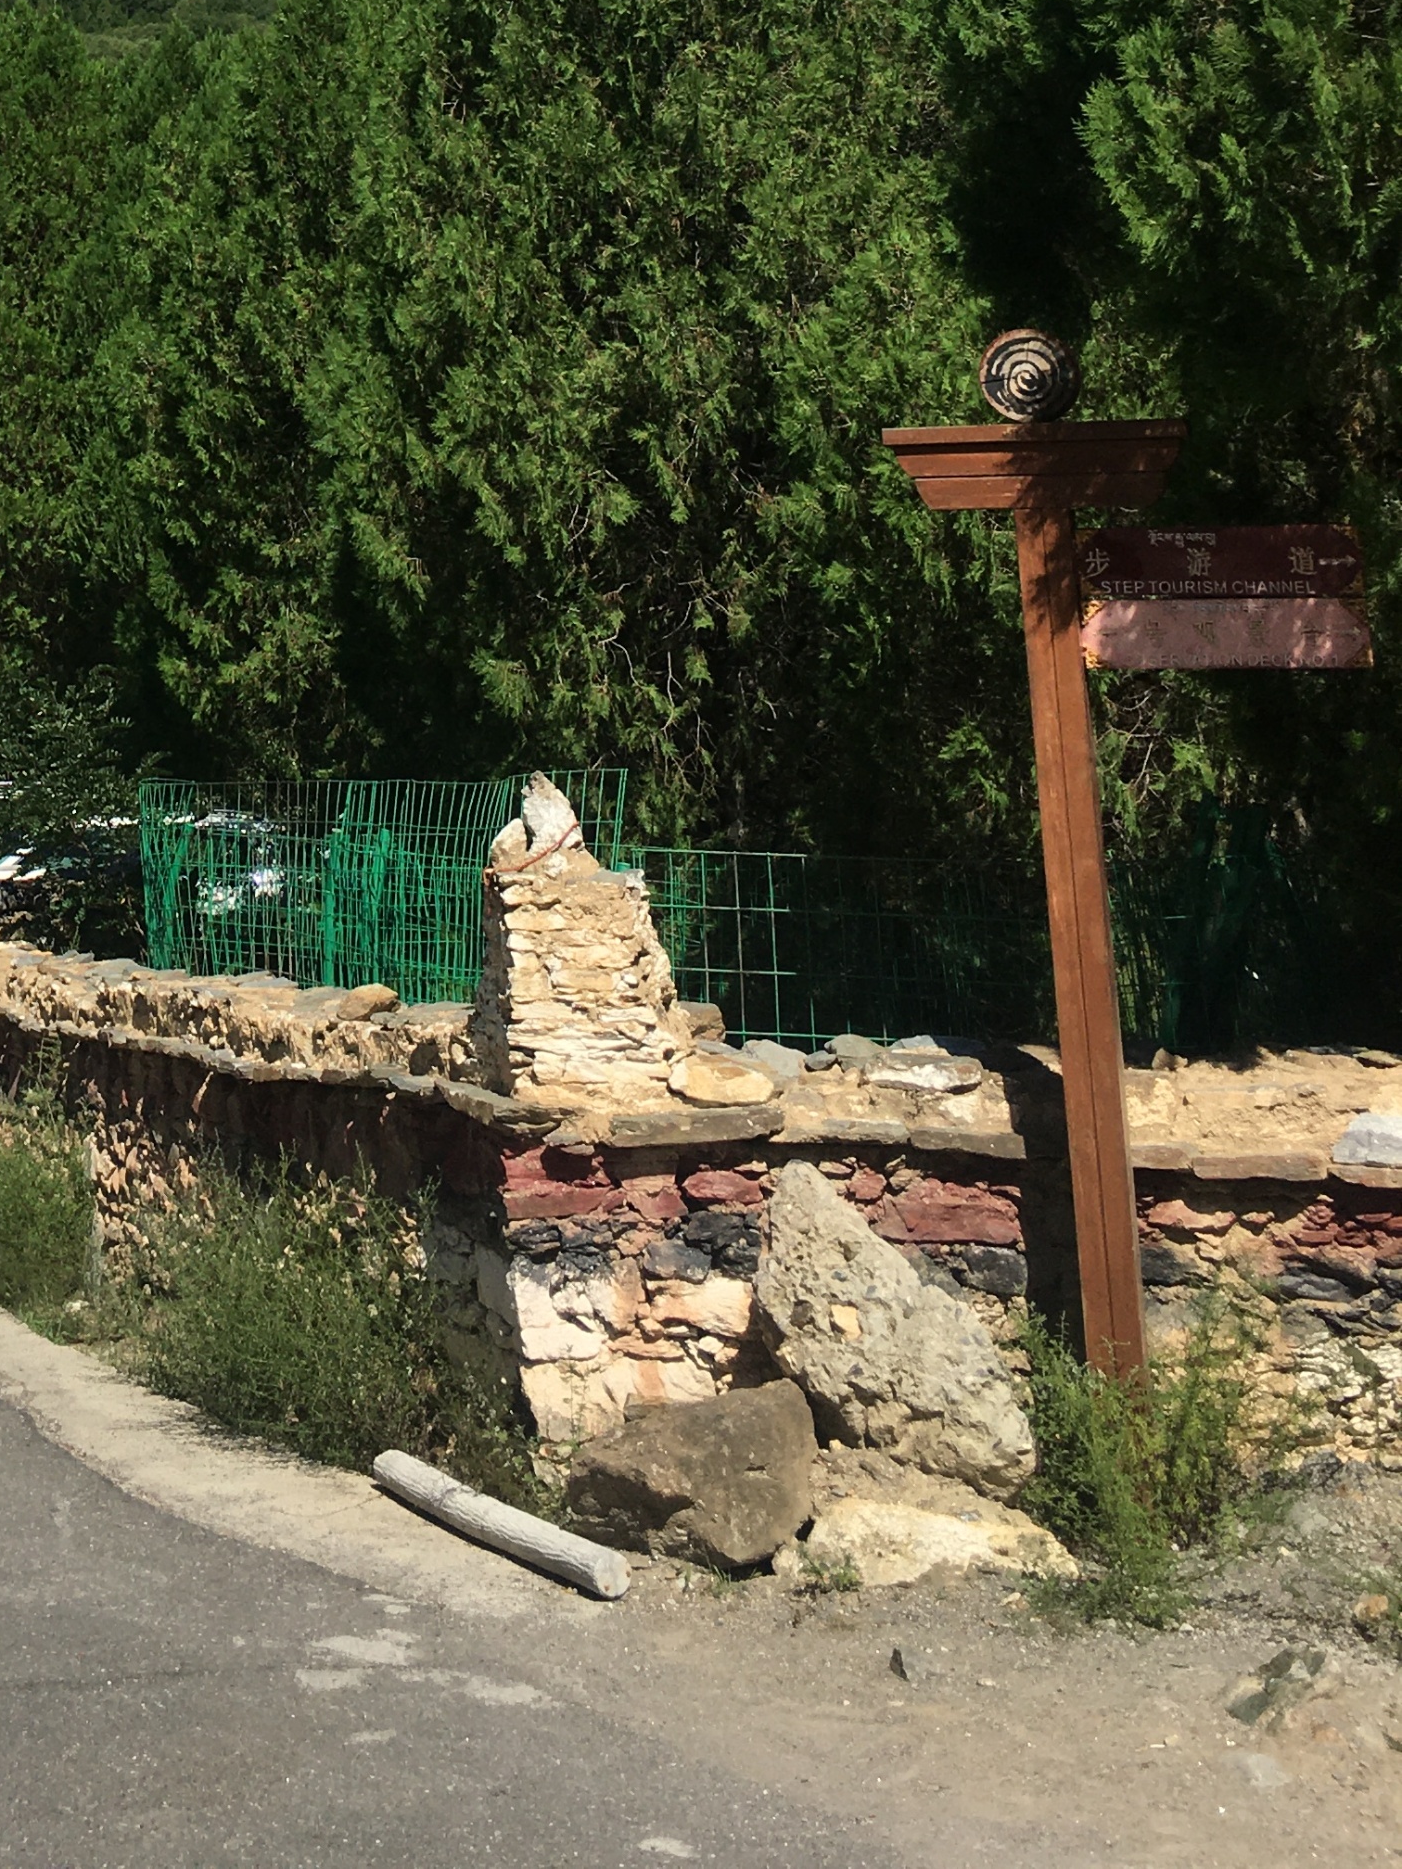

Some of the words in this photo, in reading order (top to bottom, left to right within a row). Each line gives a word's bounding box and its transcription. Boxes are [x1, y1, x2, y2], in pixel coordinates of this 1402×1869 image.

[1100, 580, 1145, 594] STEP
[1150, 580, 1227, 594] TOURISM
[1232, 579, 1316, 594] CHANNEL
[1248, 654, 1292, 667] DECK
